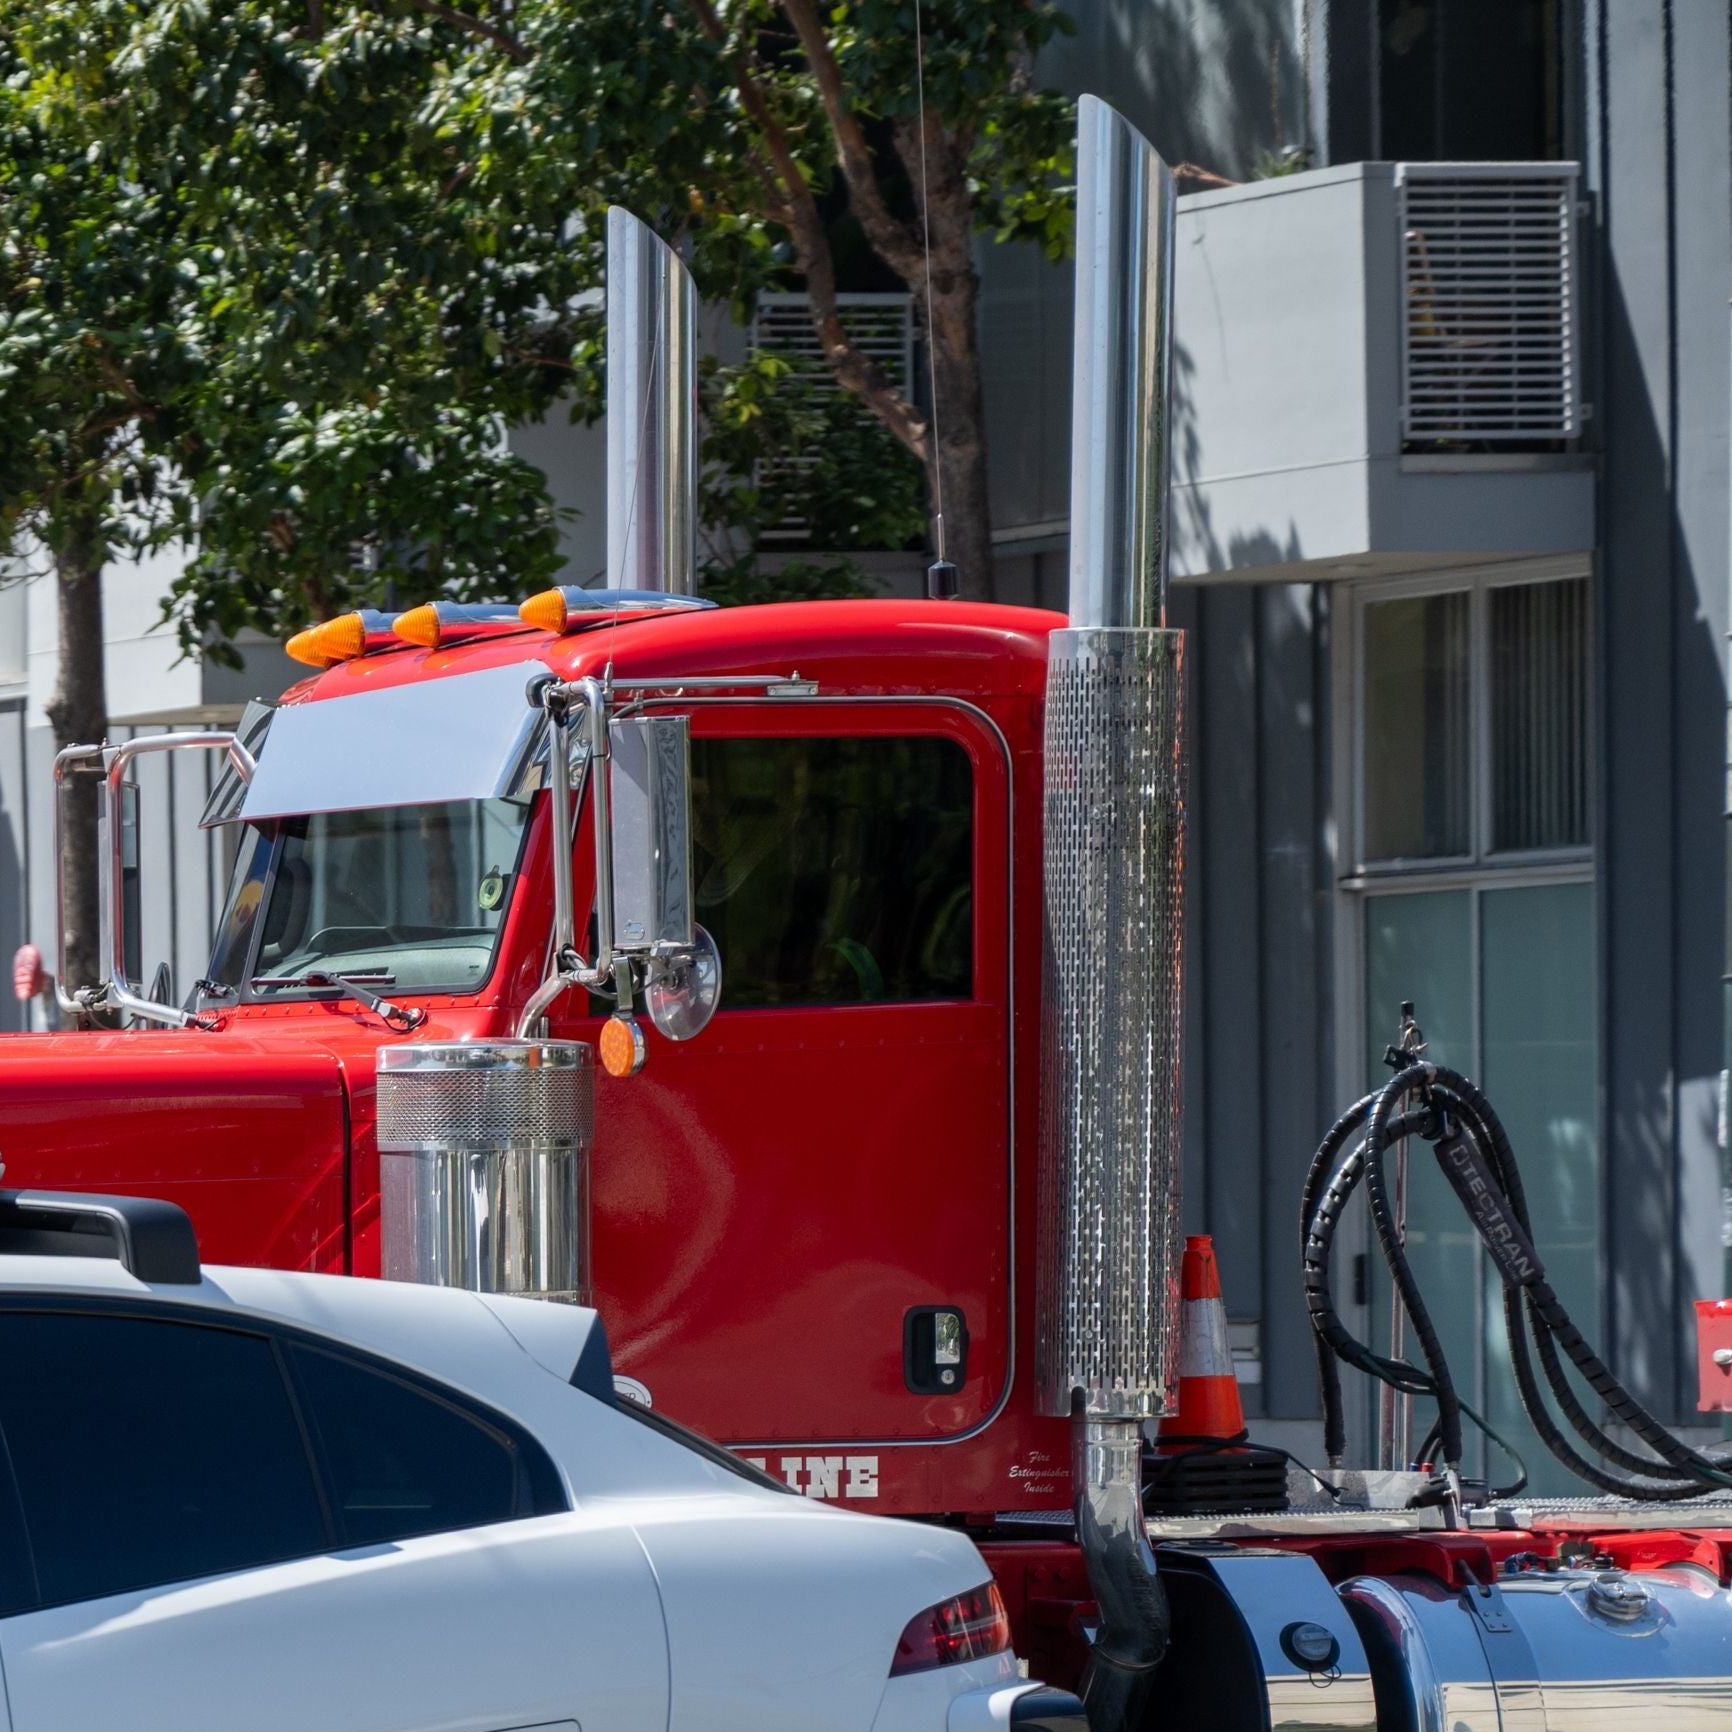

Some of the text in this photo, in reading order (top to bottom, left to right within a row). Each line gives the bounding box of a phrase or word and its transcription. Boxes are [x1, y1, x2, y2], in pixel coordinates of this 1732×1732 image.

[1462, 1162, 1535, 1278] TECTRAN
[1028, 1451, 1051, 1463] Fire
[745, 1456, 878, 1498] INE
[1009, 1465, 1069, 1480] Extinguisher
[1024, 1481, 1055, 1493] Inside
